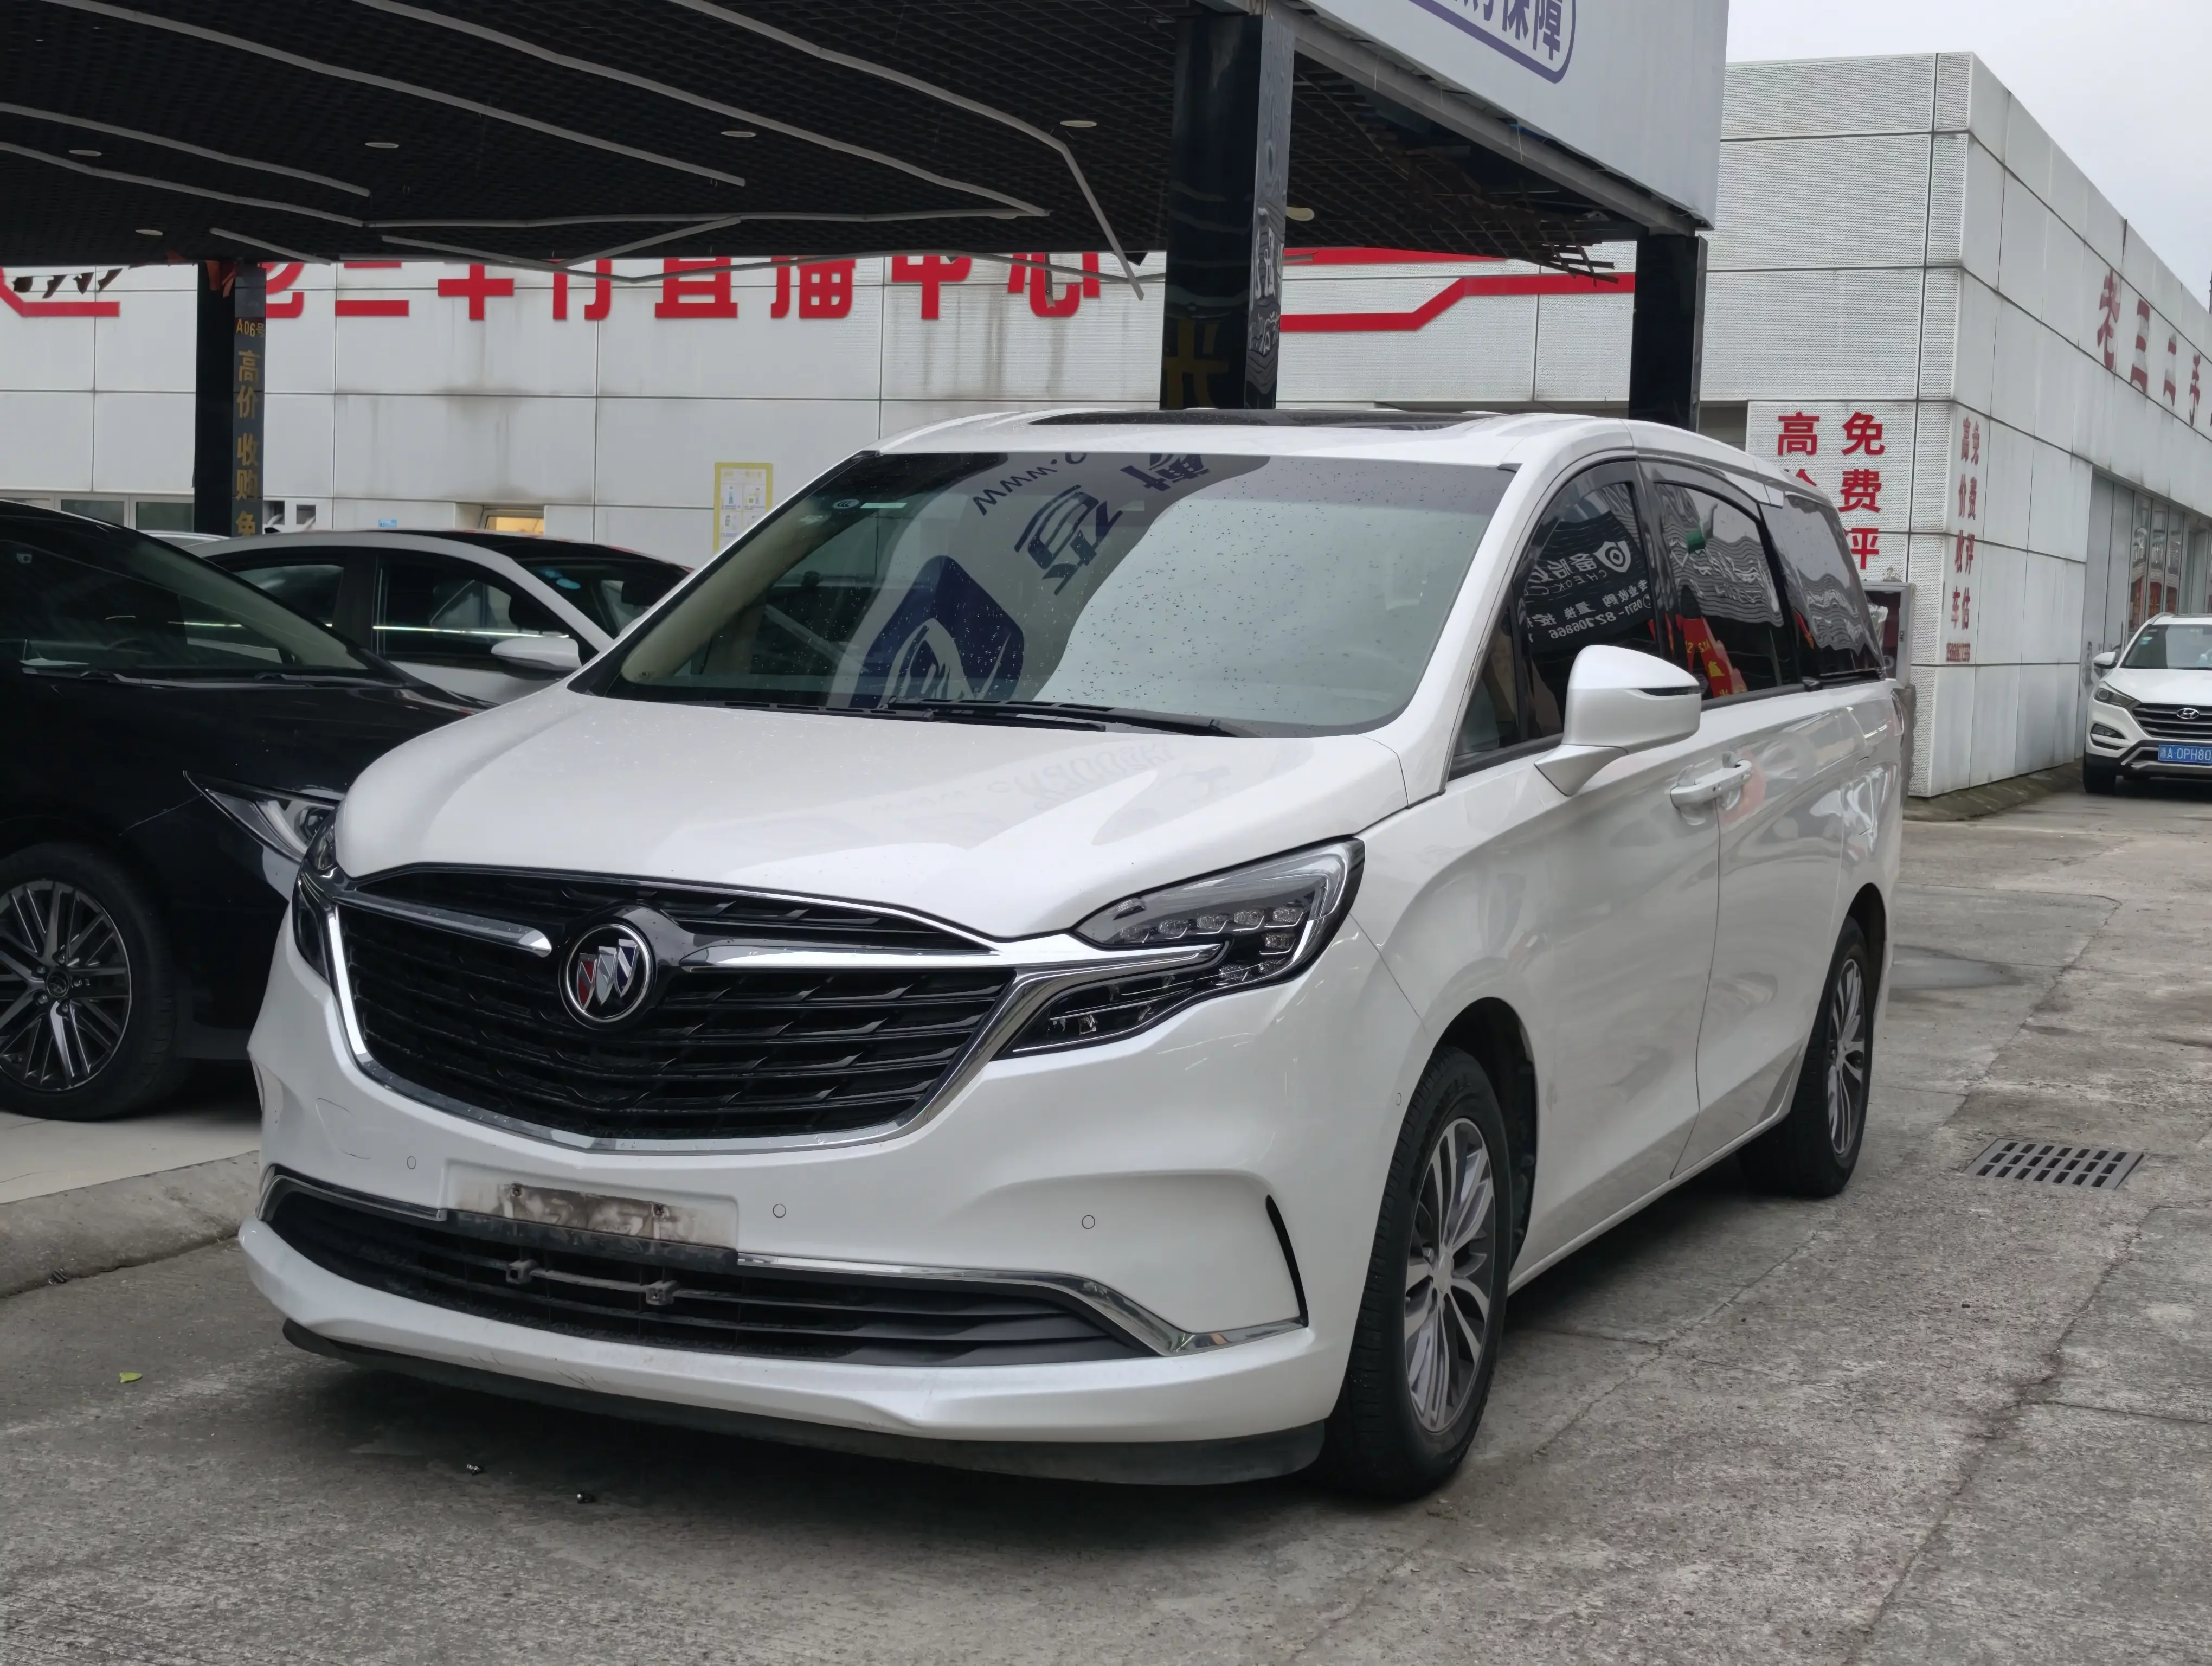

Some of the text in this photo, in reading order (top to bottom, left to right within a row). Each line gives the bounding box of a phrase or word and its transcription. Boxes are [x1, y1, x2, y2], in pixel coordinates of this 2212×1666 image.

[2097, 268, 2212, 427] 老三二手
[1838, 412, 1885, 570] 免费评
